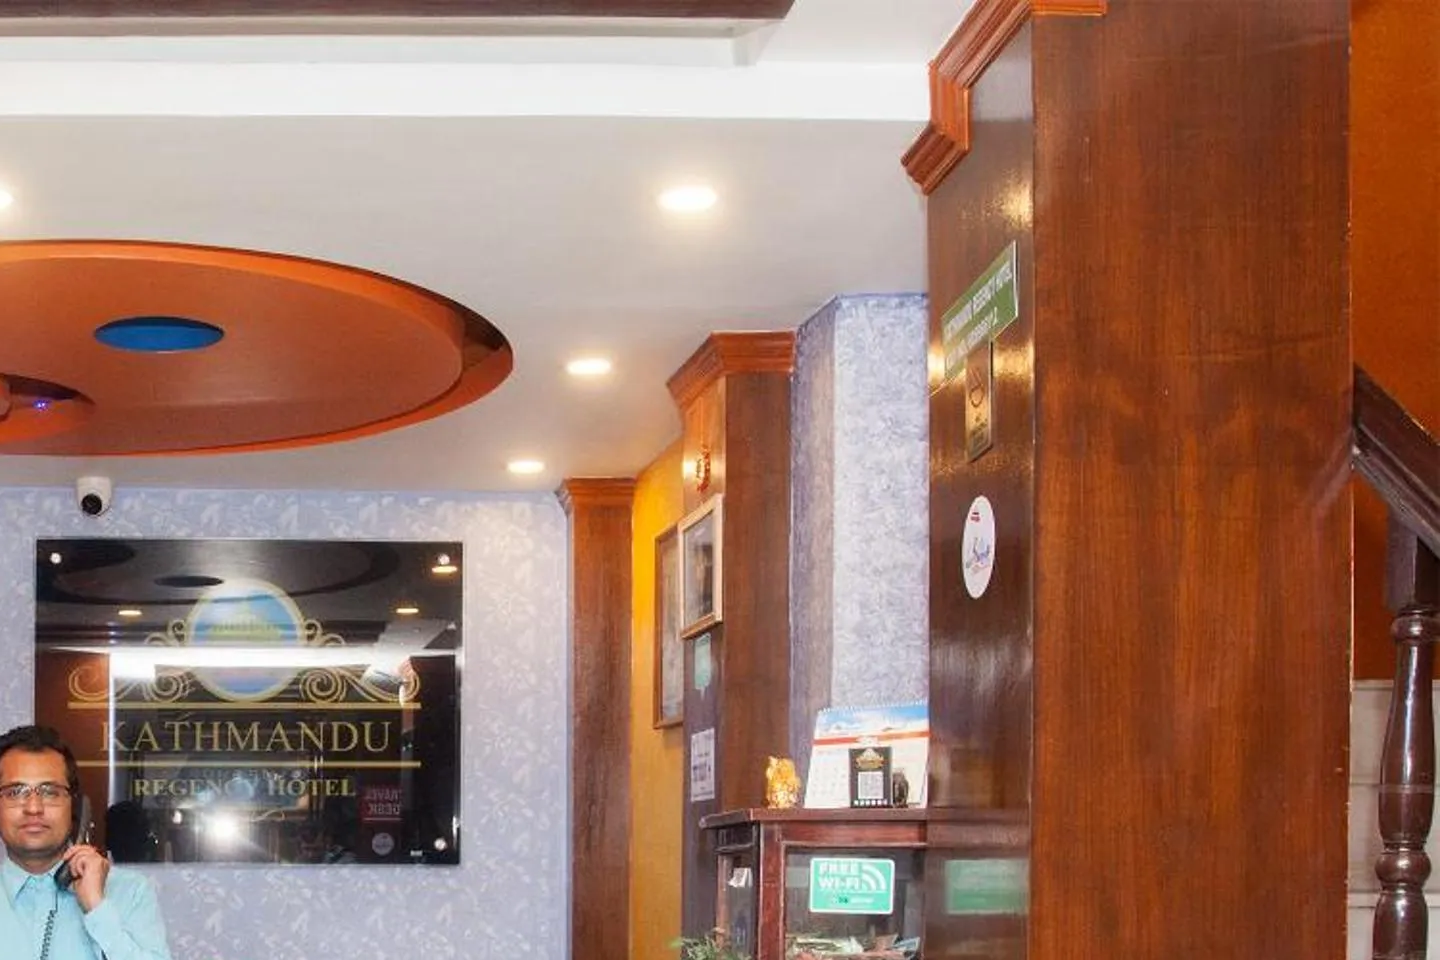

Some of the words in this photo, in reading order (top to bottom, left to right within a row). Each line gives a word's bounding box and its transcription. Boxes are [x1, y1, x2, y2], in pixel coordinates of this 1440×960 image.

[100, 721, 392, 752] KATHMANDU
[133, 778, 257, 797] REGENCY
[266, 778, 356, 797] HOTEL
[819, 861, 860, 875] FREE
